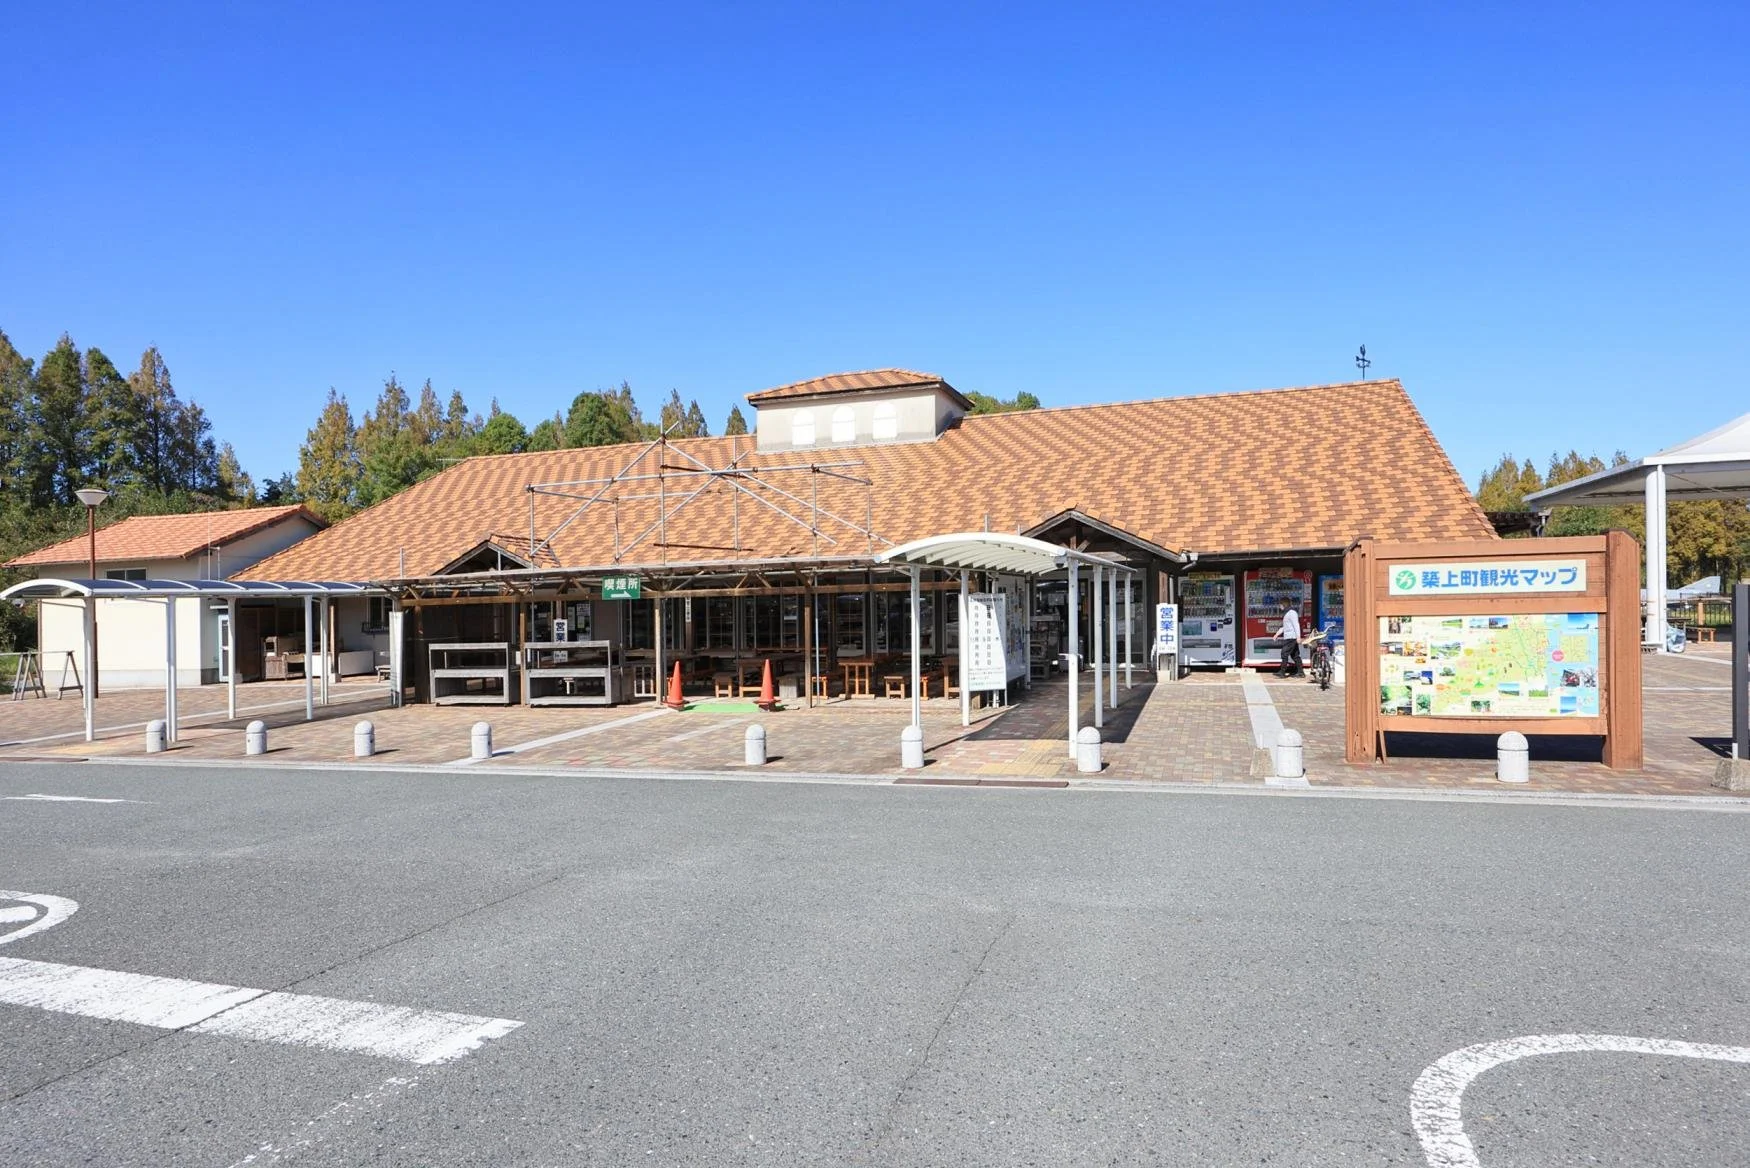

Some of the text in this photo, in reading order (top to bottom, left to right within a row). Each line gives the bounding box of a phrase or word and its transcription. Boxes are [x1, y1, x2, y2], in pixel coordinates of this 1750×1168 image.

[604, 578, 638, 590] 喫煙所
[1421, 567, 1578, 588] 築上町観光マップ
[1160, 607, 1174, 645] 営業中
